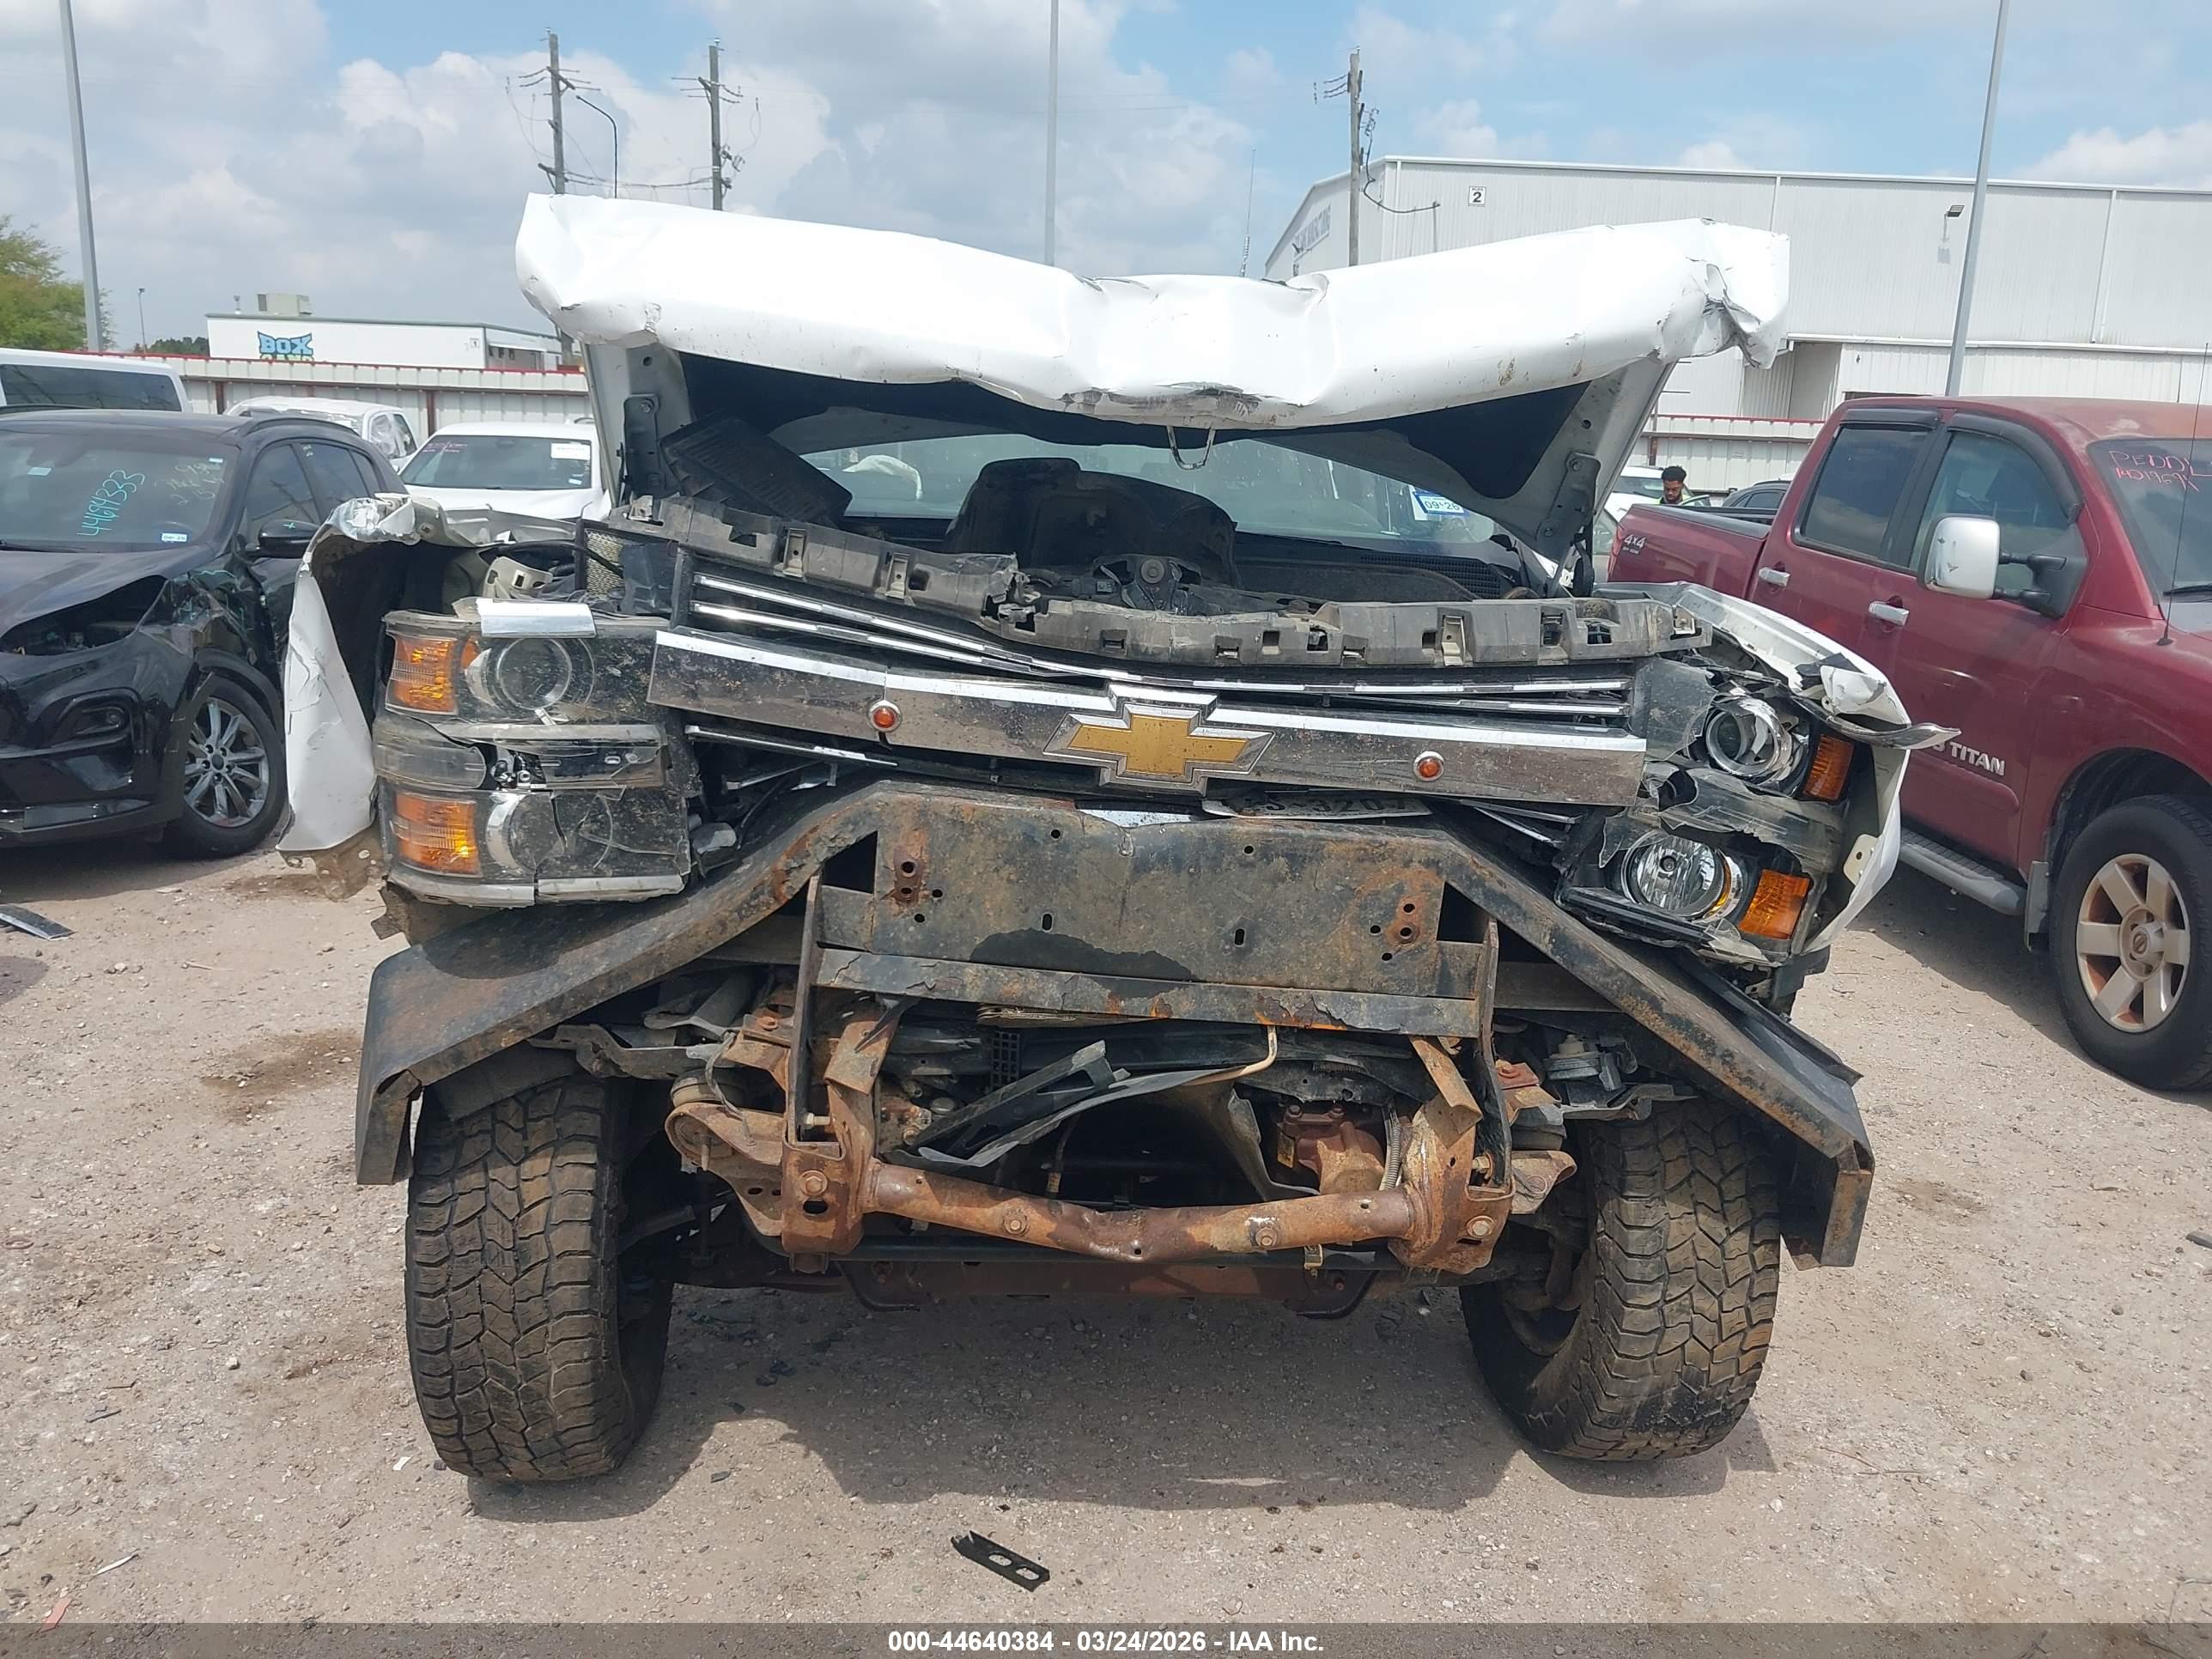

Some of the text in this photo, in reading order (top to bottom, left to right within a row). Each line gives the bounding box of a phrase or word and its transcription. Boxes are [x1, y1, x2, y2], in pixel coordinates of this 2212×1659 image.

[1473, 191, 1482, 203] 2
[257, 331, 314, 356] BOX
[1949, 741, 2006, 776] TITAN
